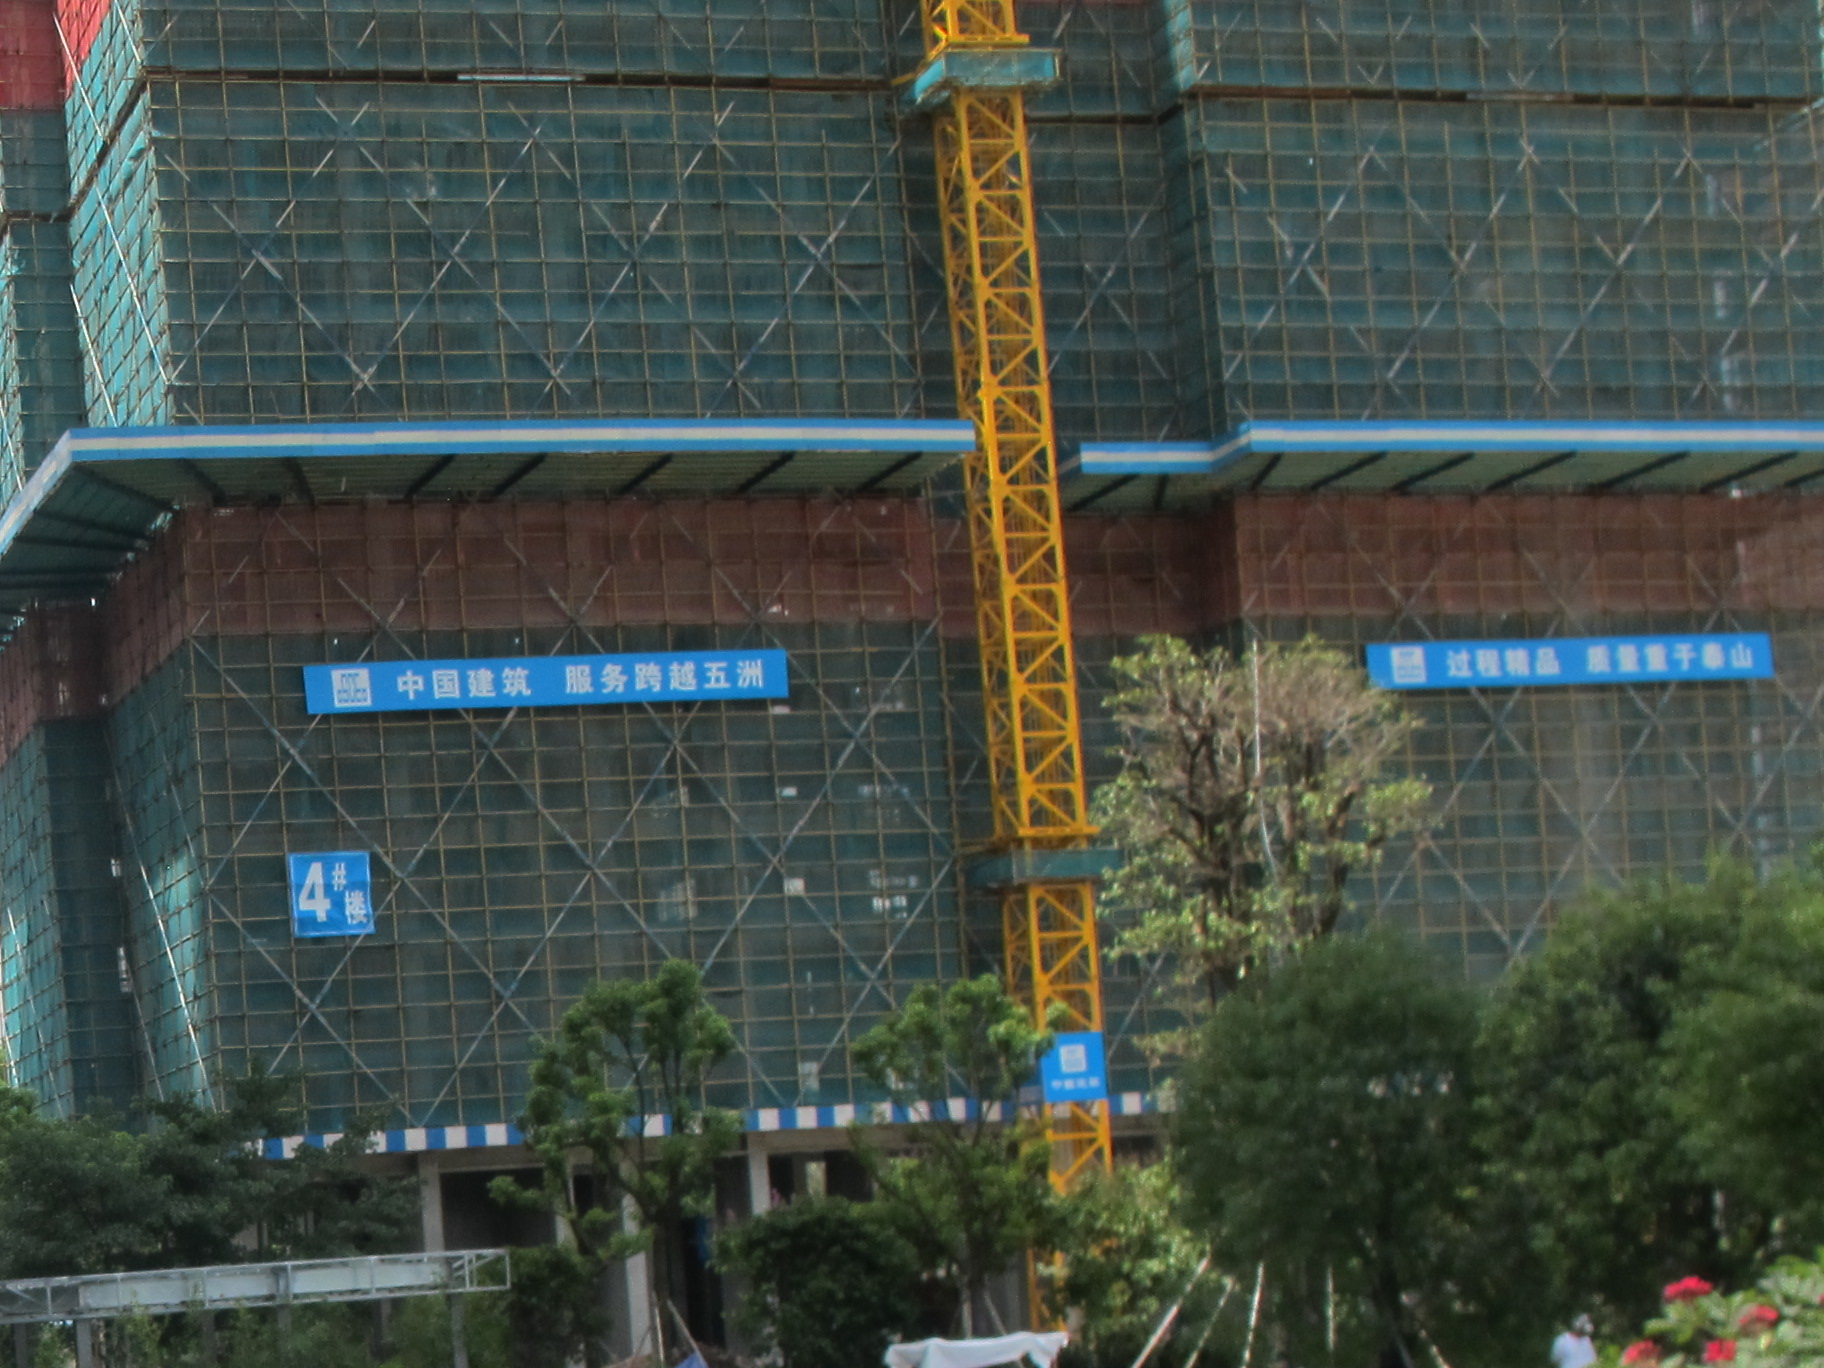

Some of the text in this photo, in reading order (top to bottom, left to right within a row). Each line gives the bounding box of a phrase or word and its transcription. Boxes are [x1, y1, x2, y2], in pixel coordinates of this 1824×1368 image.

[396, 659, 765, 699] 中国建筑 服务跨越五洲
